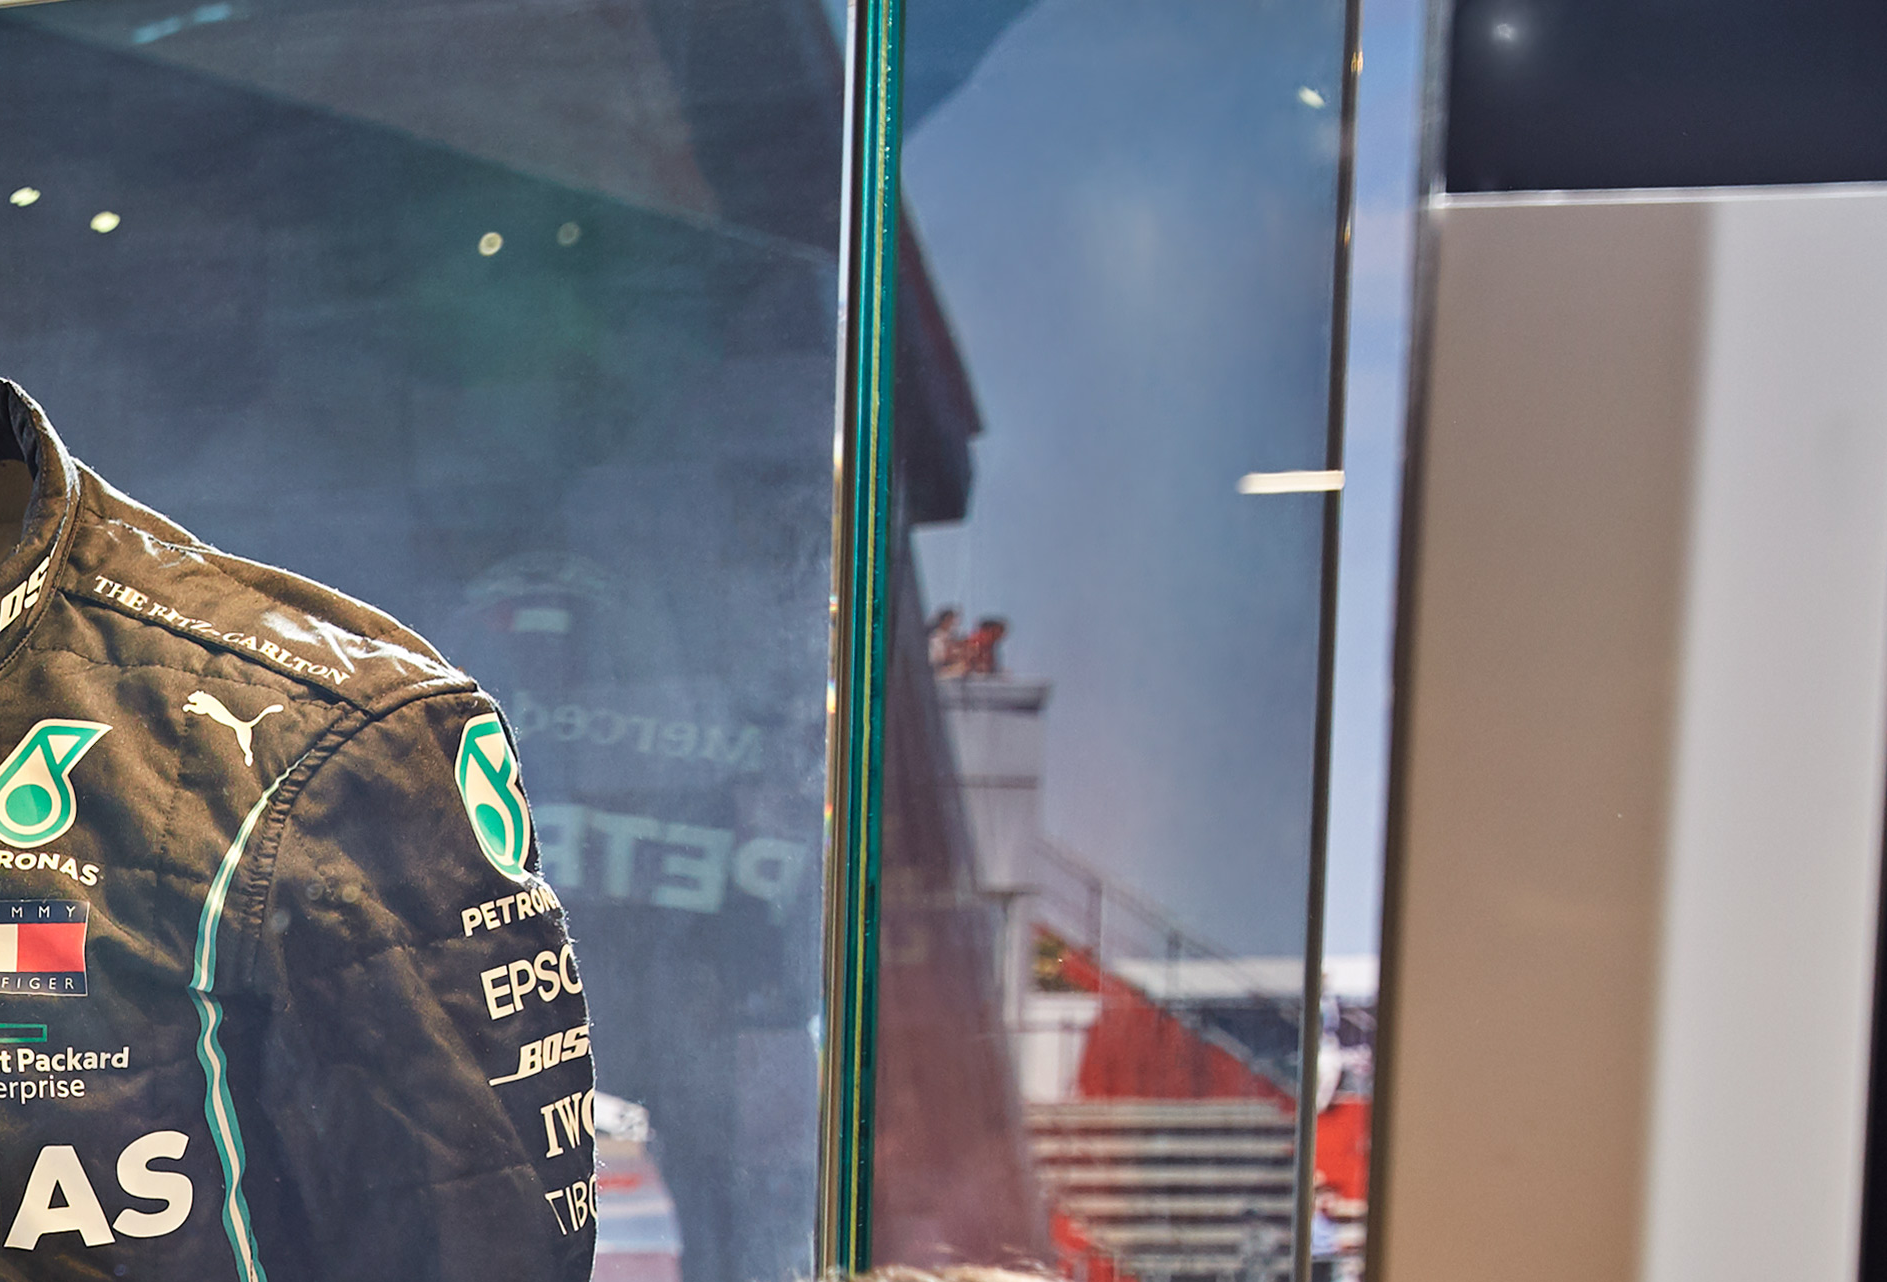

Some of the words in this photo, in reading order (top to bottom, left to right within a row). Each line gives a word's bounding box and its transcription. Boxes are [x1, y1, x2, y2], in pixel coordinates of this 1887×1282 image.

[95, 575, 148, 611] THE
[149, 602, 351, 685] RITZ-CARLTON
[481, 943, 583, 1021] EPSO
[16, 1046, 130, 1074] Packard
[489, 1024, 591, 1086] BOS
